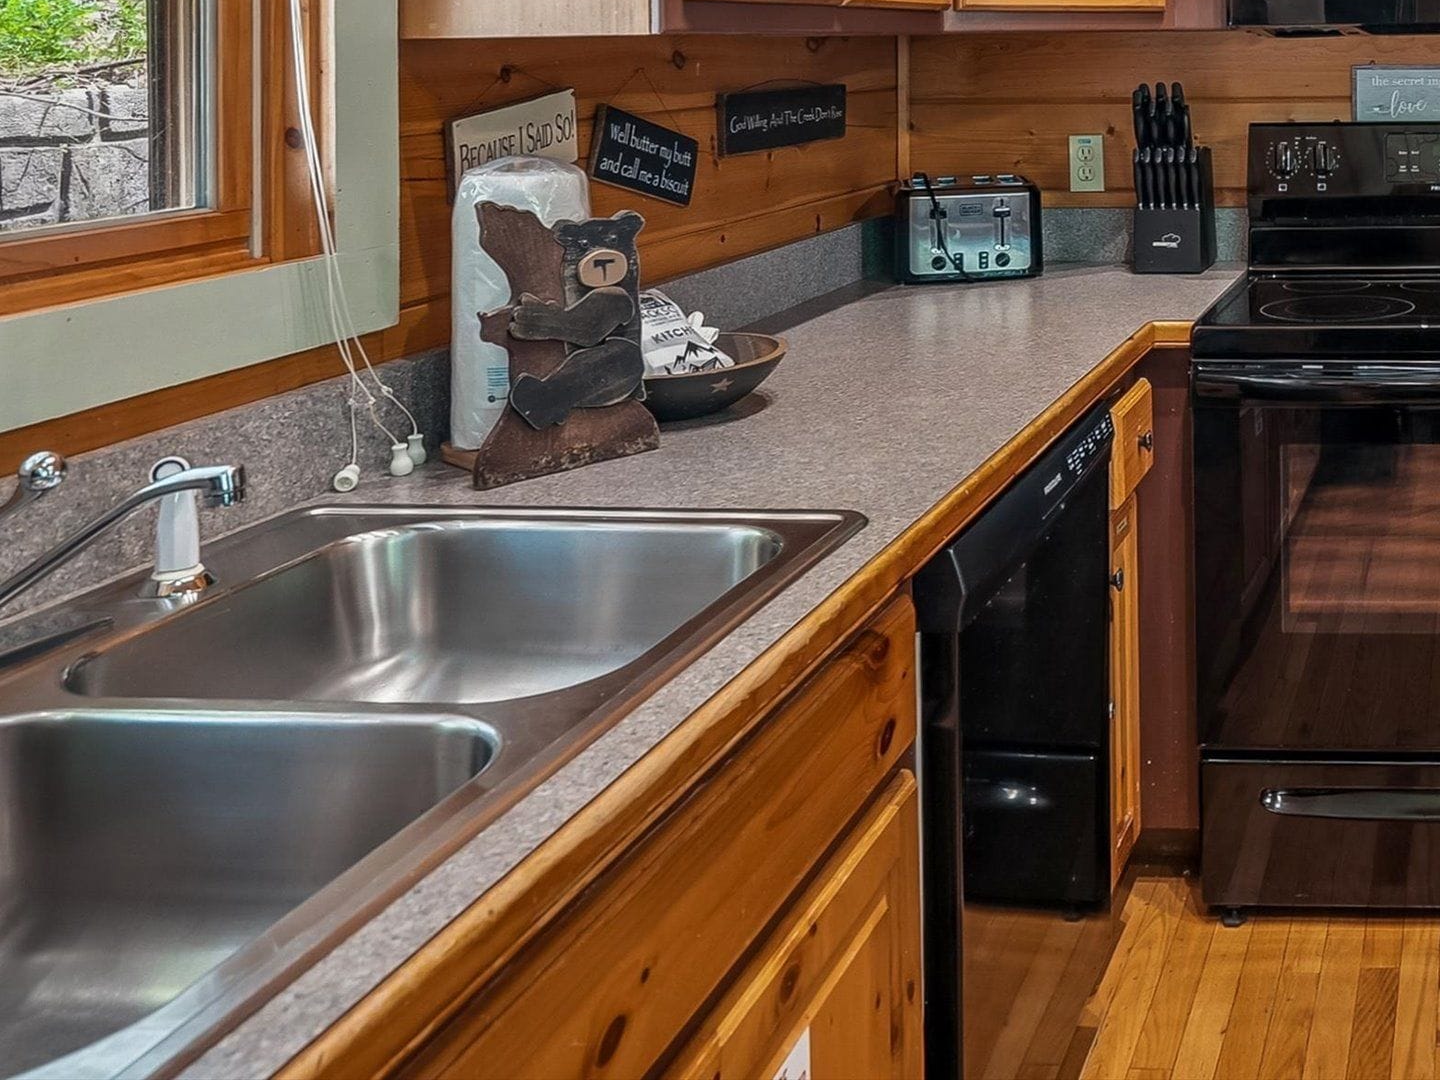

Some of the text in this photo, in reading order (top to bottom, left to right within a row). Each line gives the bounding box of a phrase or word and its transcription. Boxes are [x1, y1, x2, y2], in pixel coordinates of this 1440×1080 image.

[1372, 74, 1389, 87] the
[1392, 77, 1424, 87] secret
[1376, 90, 1429, 119] love
[518, 125, 525, 155] I
[610, 122, 692, 169] Well butter my butt
[599, 151, 690, 196] and call me a biscuit
[650, 325, 697, 345] KITCH
